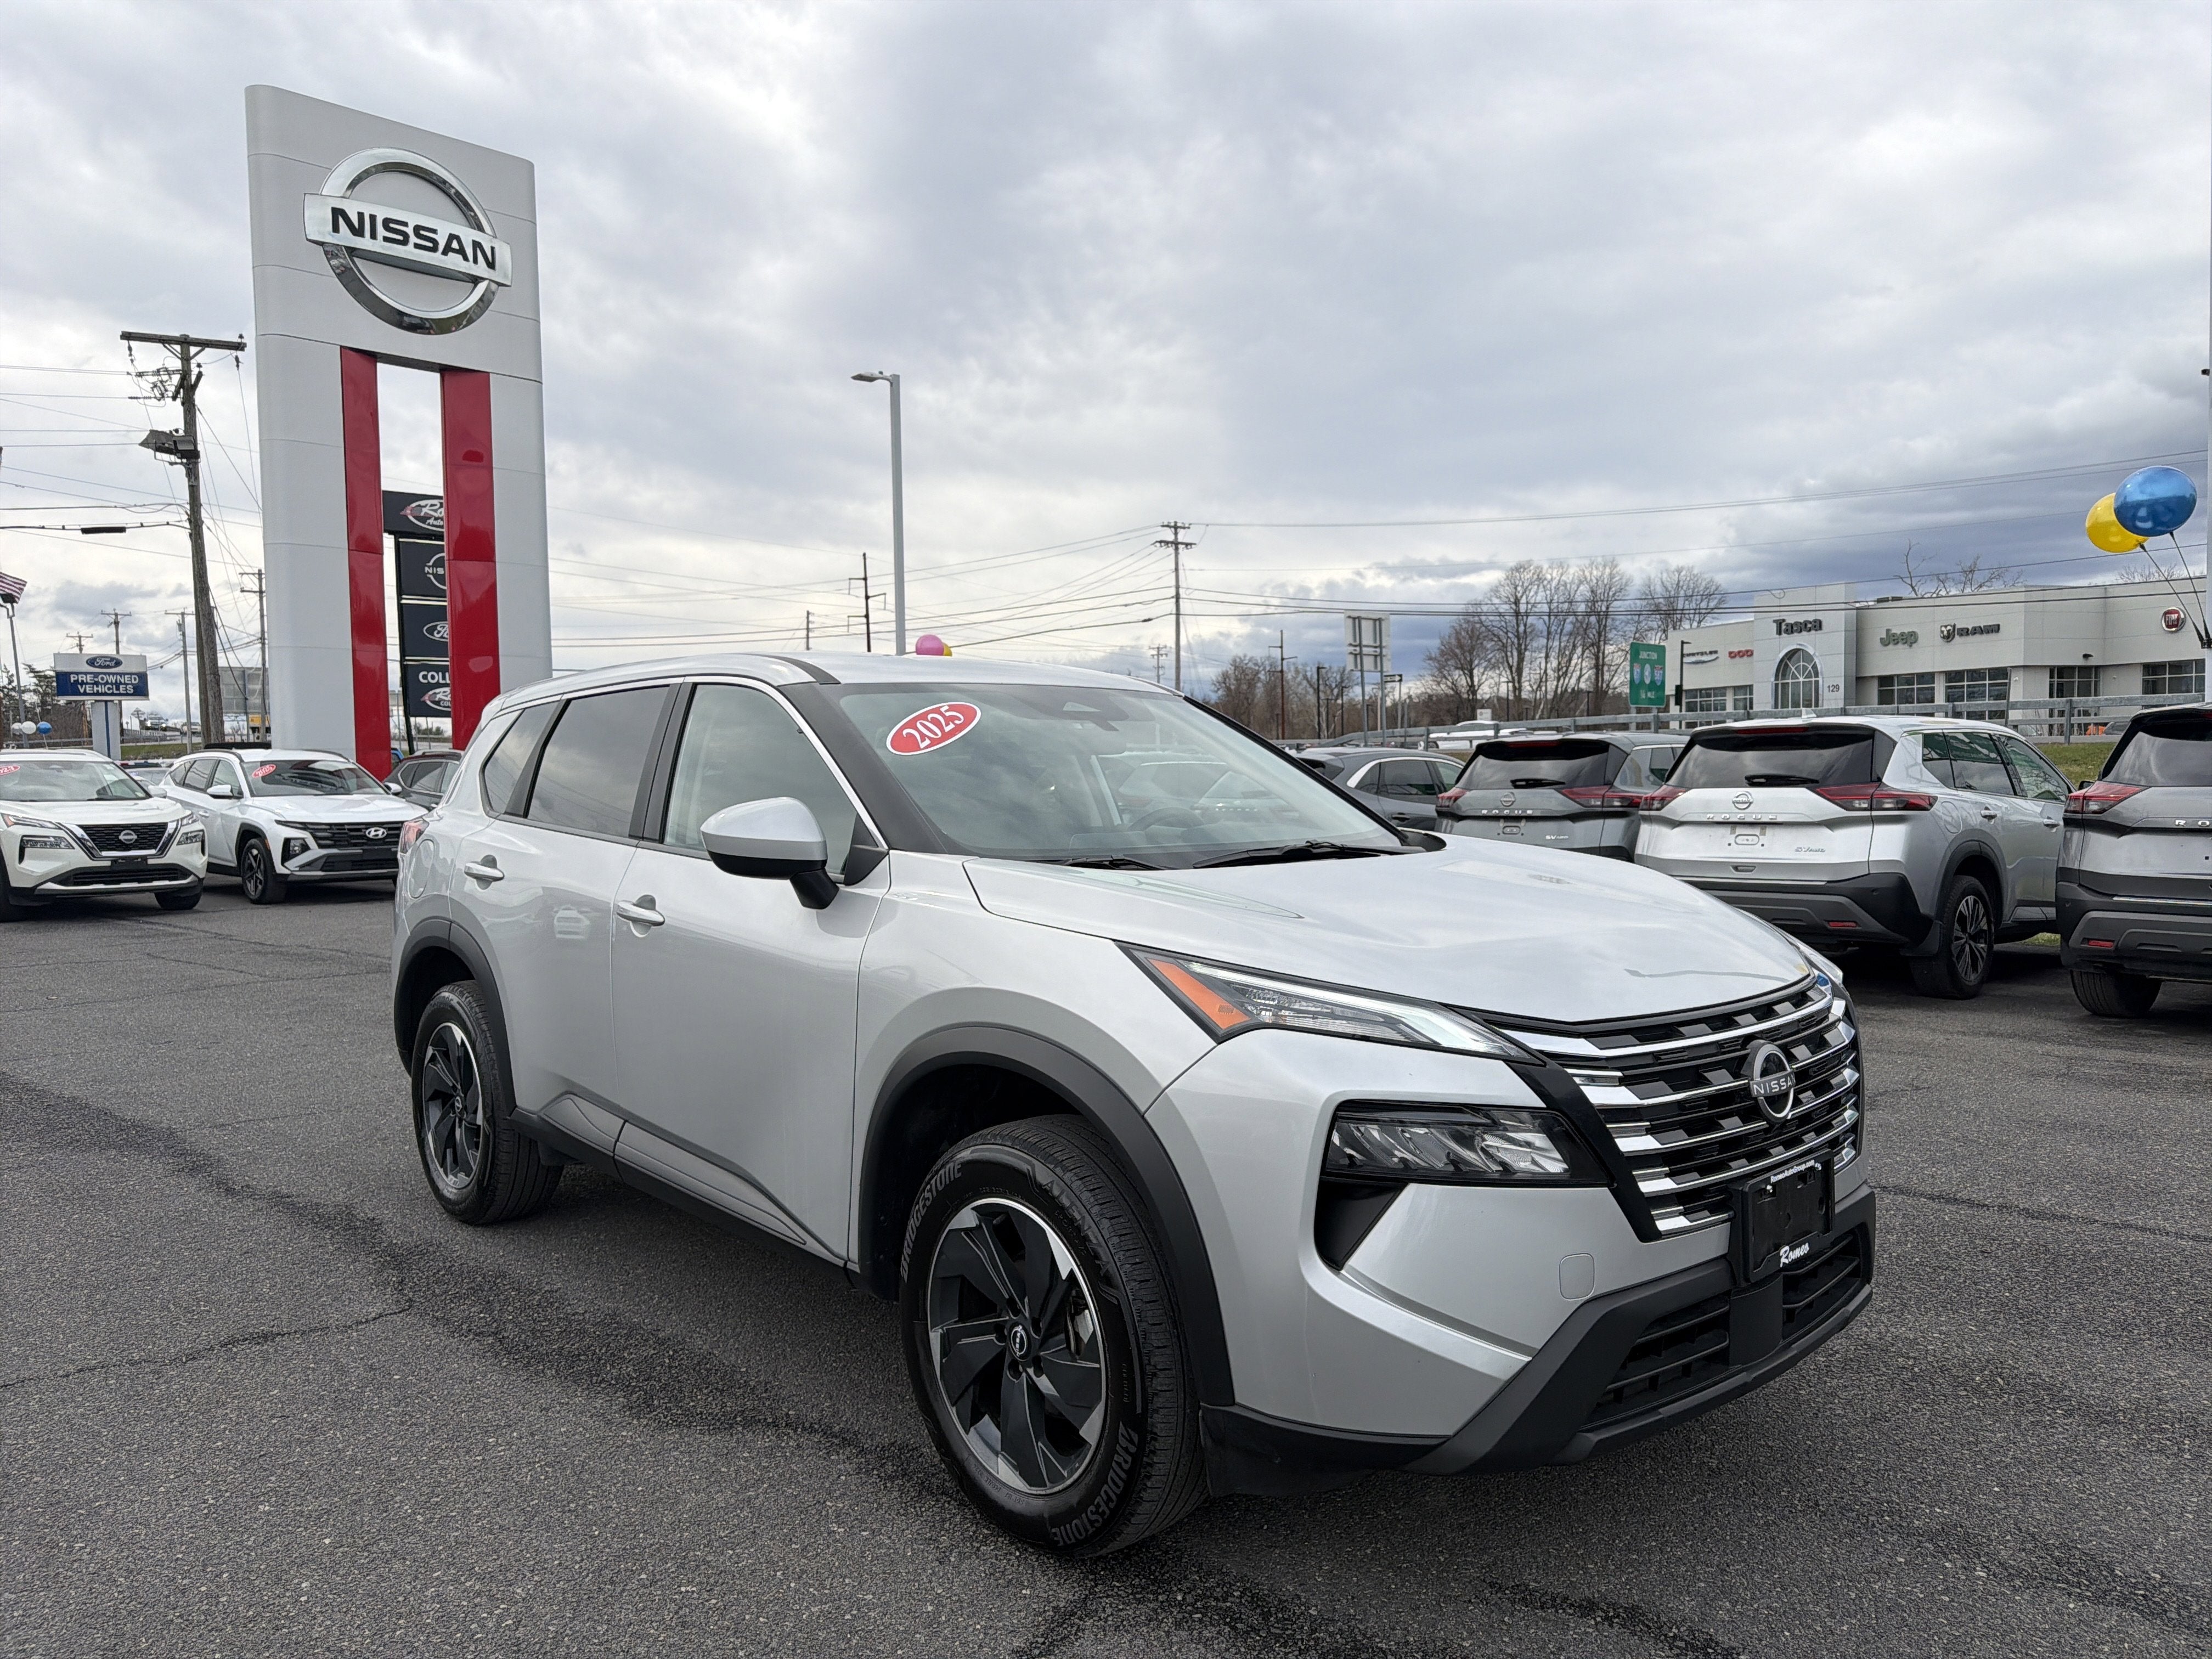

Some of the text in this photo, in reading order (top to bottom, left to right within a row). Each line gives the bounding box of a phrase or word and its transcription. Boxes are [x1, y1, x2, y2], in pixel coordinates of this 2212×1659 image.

[331, 207, 496, 271] NISSAN
[1773, 618, 1822, 636] Tasca
[1956, 623, 2000, 637] RAM
[1880, 628, 1919, 647] Jeep
[94, 658, 115, 667] Ford
[70, 674, 139, 684] PRE-OWNED
[77, 684, 134, 694] VEHICLES
[1827, 684, 1840, 693] 129
[902, 705, 964, 749] 2025
[1753, 1073, 1796, 1095] NISSAN
[1780, 1242, 1810, 1268] Romeo
